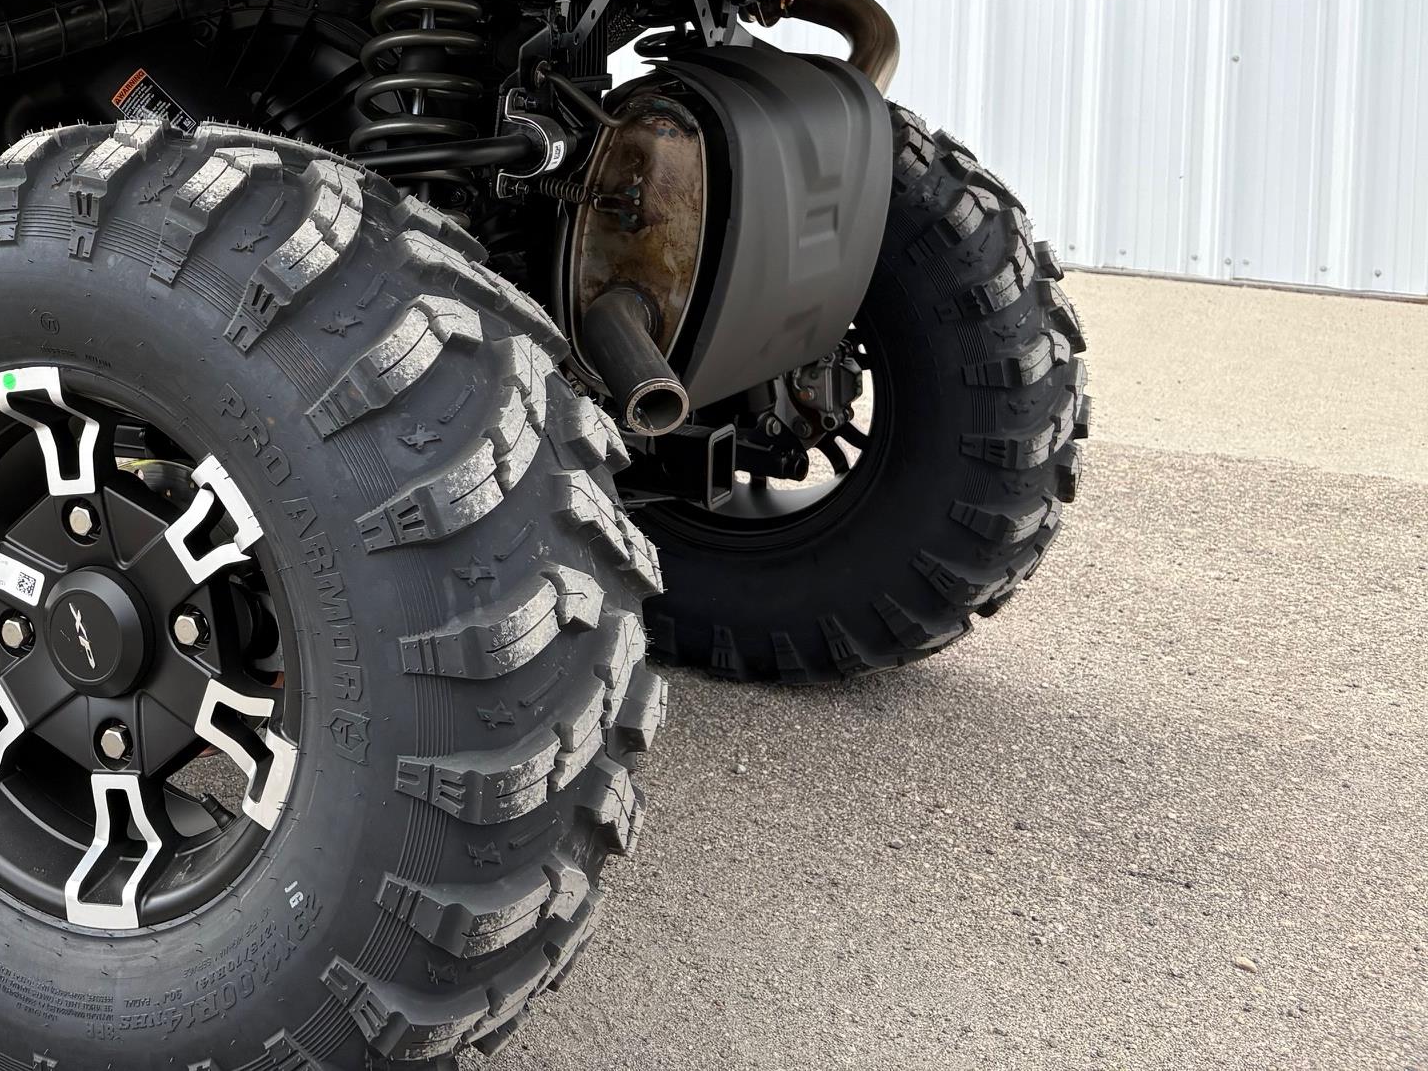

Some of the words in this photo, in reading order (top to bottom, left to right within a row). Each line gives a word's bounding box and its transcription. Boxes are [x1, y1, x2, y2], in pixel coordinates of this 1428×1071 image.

[119, 71, 145, 99] WARNING
[213, 382, 292, 487] PRO
[282, 495, 364, 703] ARMOR
